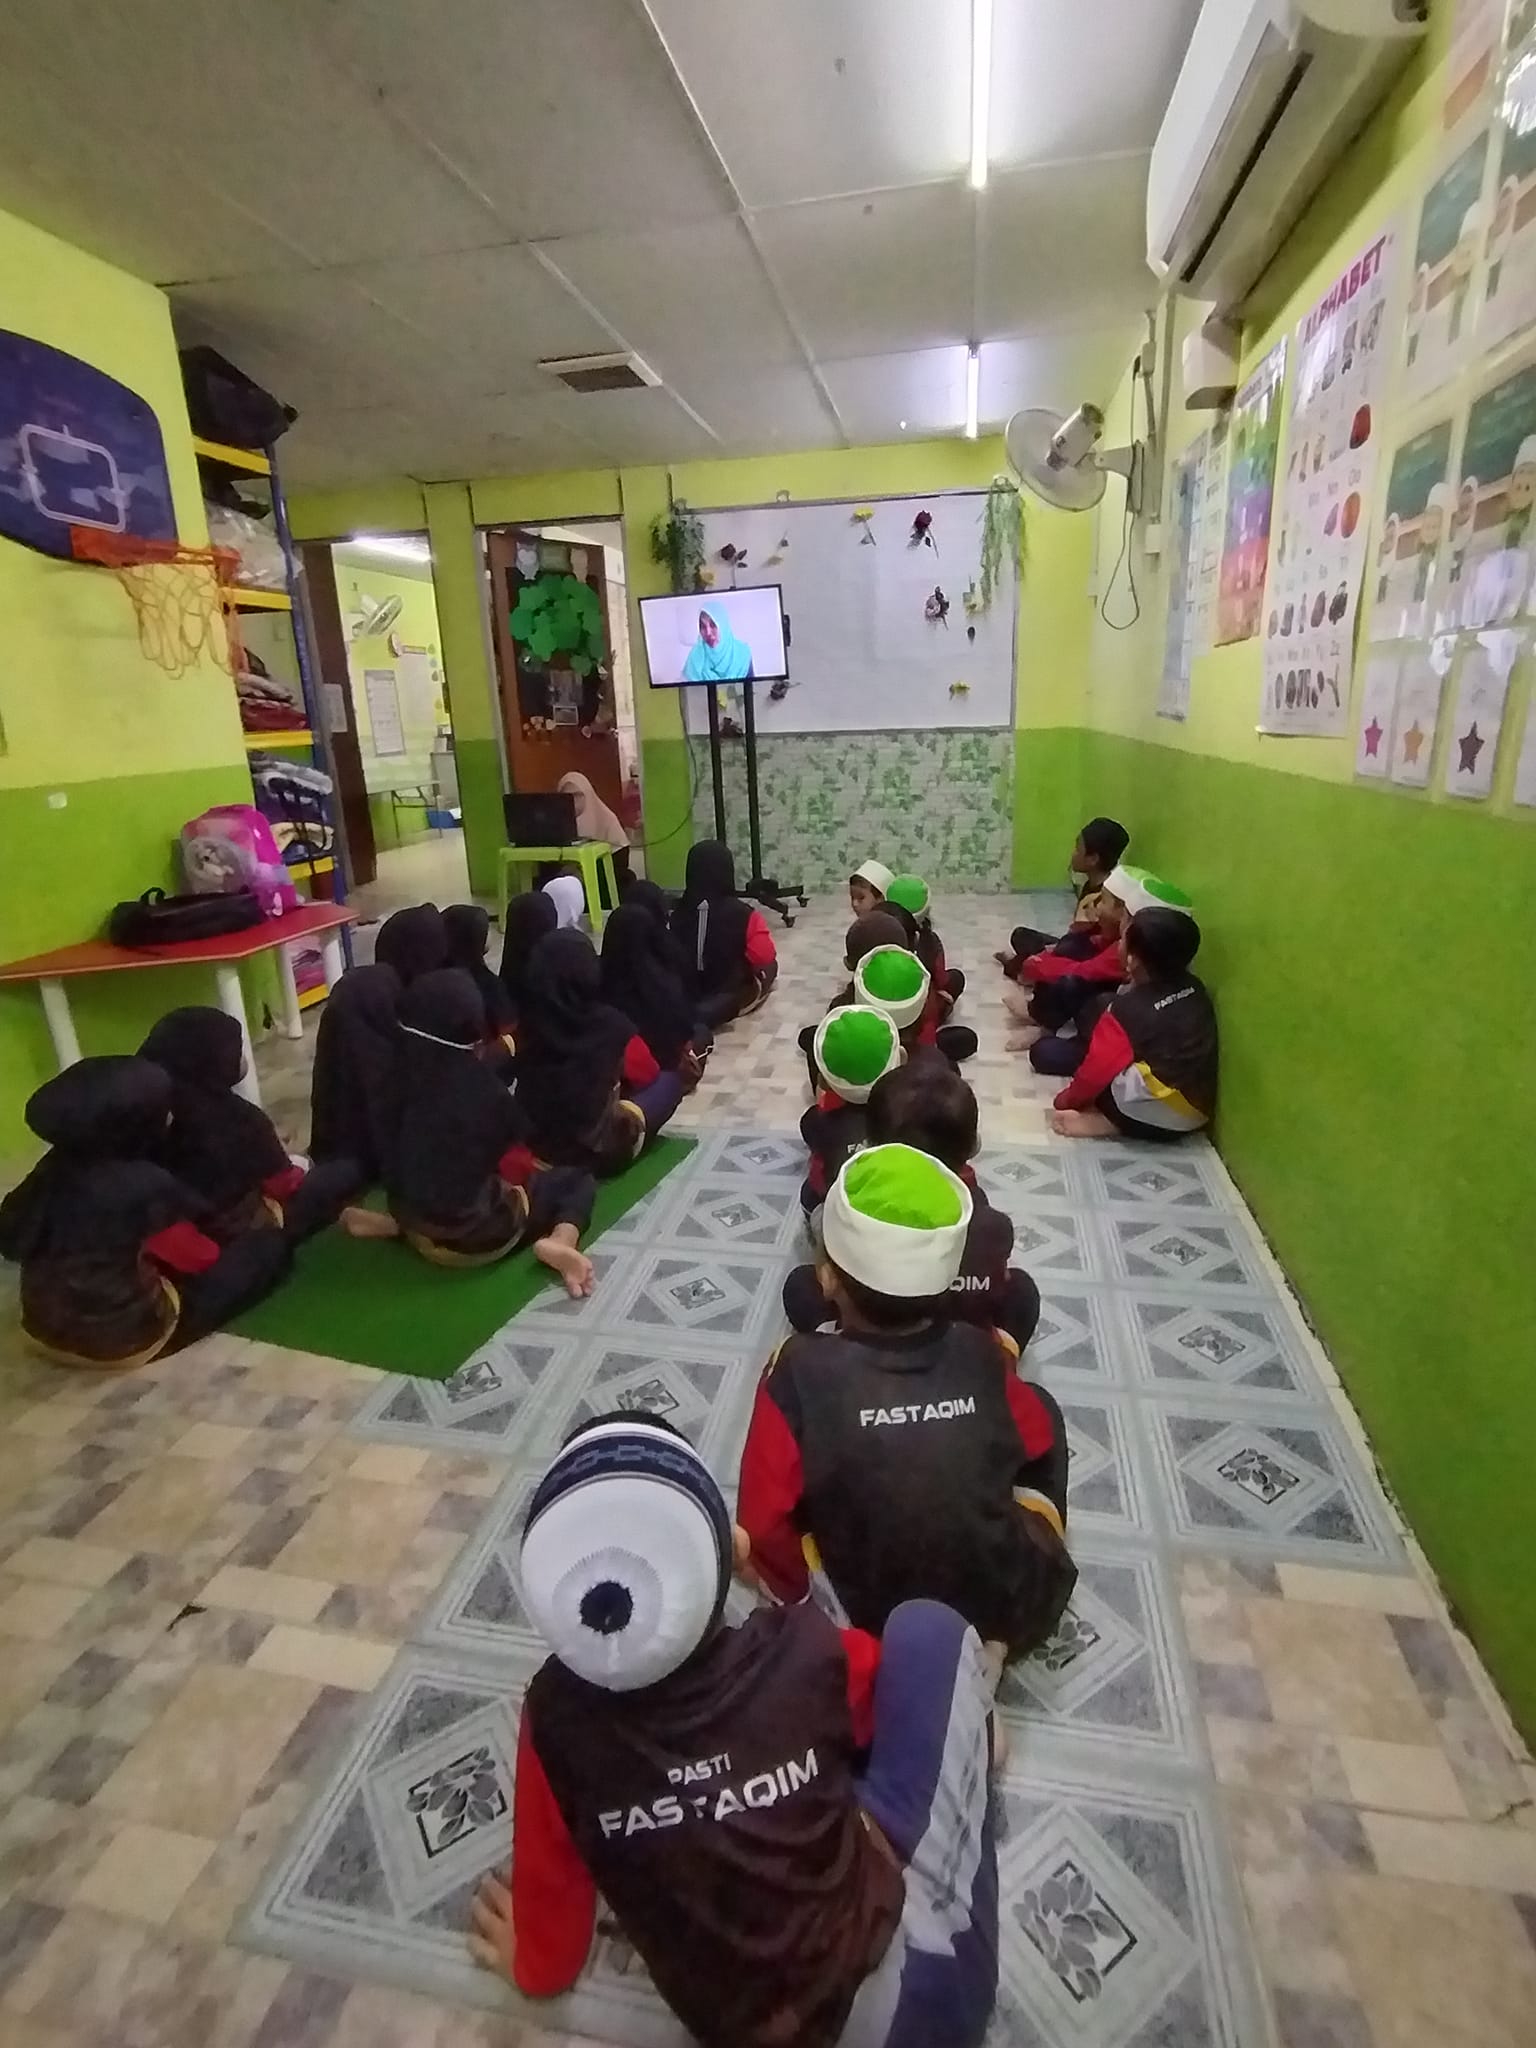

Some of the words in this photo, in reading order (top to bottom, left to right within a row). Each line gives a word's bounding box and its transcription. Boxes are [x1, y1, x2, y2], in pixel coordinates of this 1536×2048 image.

[1303, 235, 1386, 347] ALPHABET
[859, 1397, 976, 1427] FASTAQIM
[667, 1753, 732, 1785] PASTI
